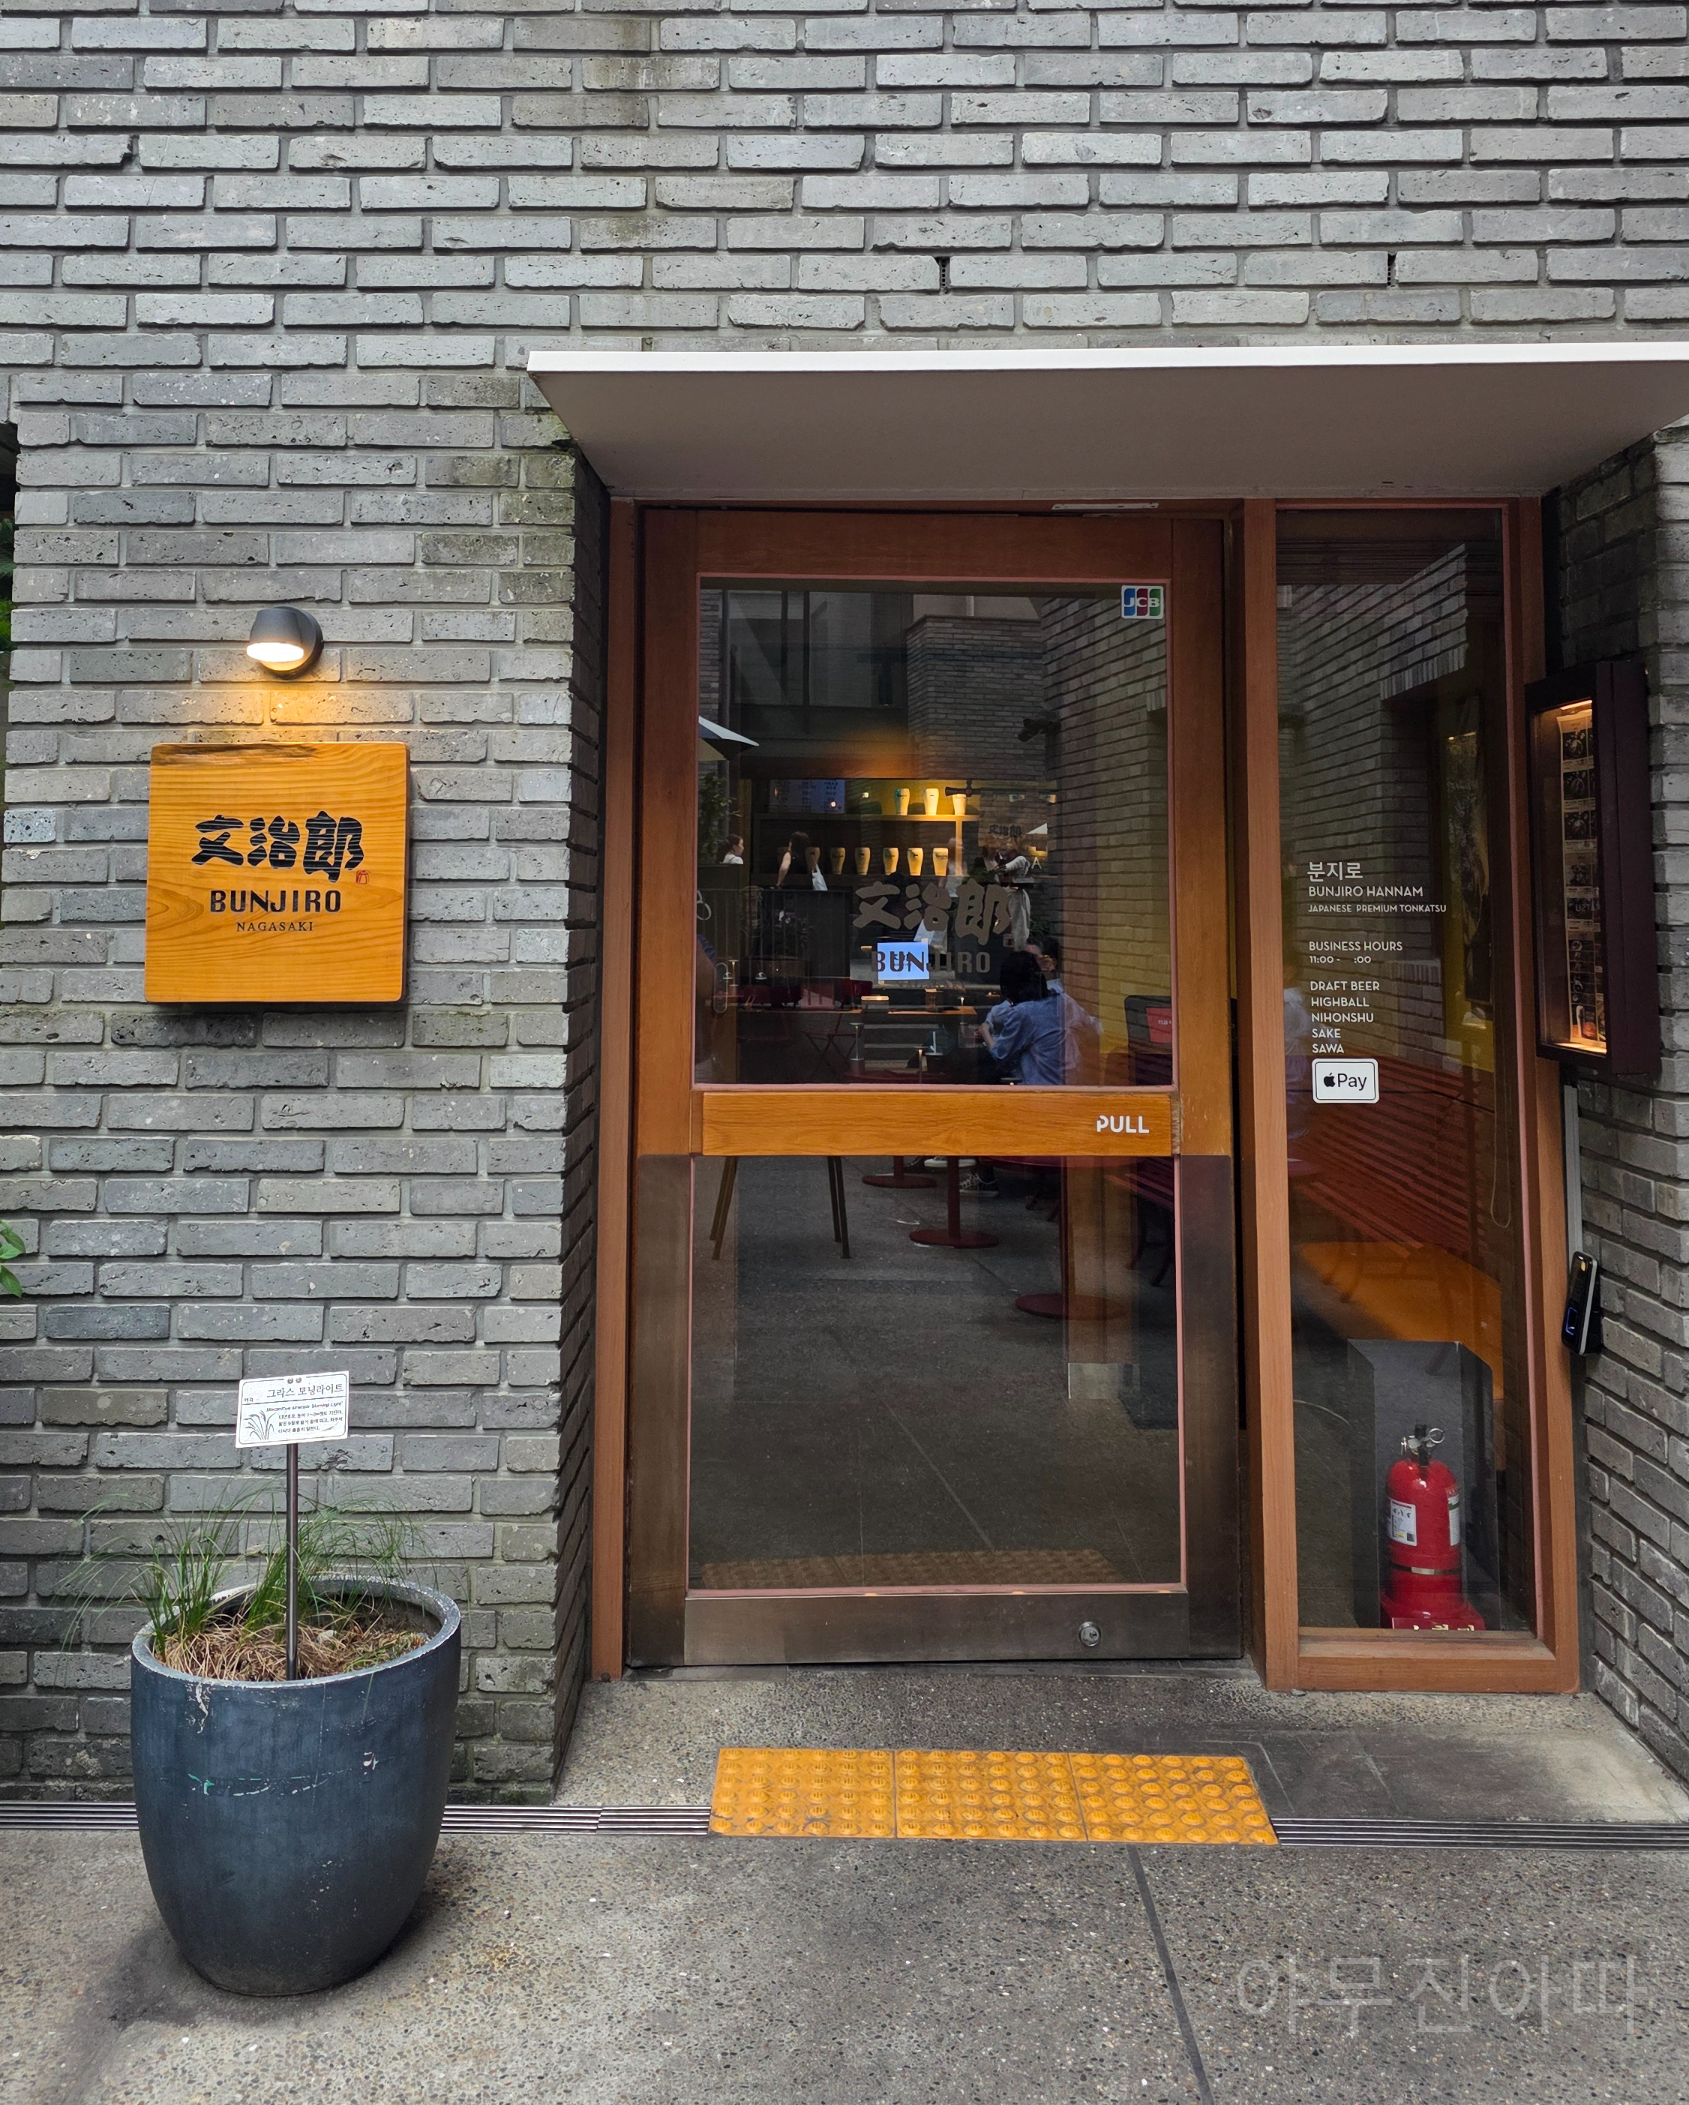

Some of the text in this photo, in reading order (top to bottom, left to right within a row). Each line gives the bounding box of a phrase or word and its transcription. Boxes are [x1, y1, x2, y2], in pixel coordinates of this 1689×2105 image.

[1124, 597, 1160, 607] JCB
[191, 811, 364, 883] 文治郎
[1307, 862, 1364, 882] 분지로
[1308, 886, 1424, 897] BUNJIRO HANNAM
[209, 889, 341, 913] BUNJIRO
[852, 878, 1011, 946] 文治郎
[1308, 904, 1447, 913] JAPANESE PREMIUM TONKATSU
[236, 921, 313, 932] NAGASAKI
[1309, 941, 1403, 951] BUSINESS HOURS
[871, 951, 991, 974] BUNJIRO
[1310, 981, 1380, 991] DRAFT BEER
[1311, 997, 1370, 1007] HIGHBALL
[1311, 1012, 1374, 1023] NIHONSHU
[1312, 1028, 1341, 1039] SAKE
[1312, 1043, 1345, 1054] SAWA
[1337, 1073, 1367, 1091] Pay
[1096, 1115, 1150, 1134] PULL
